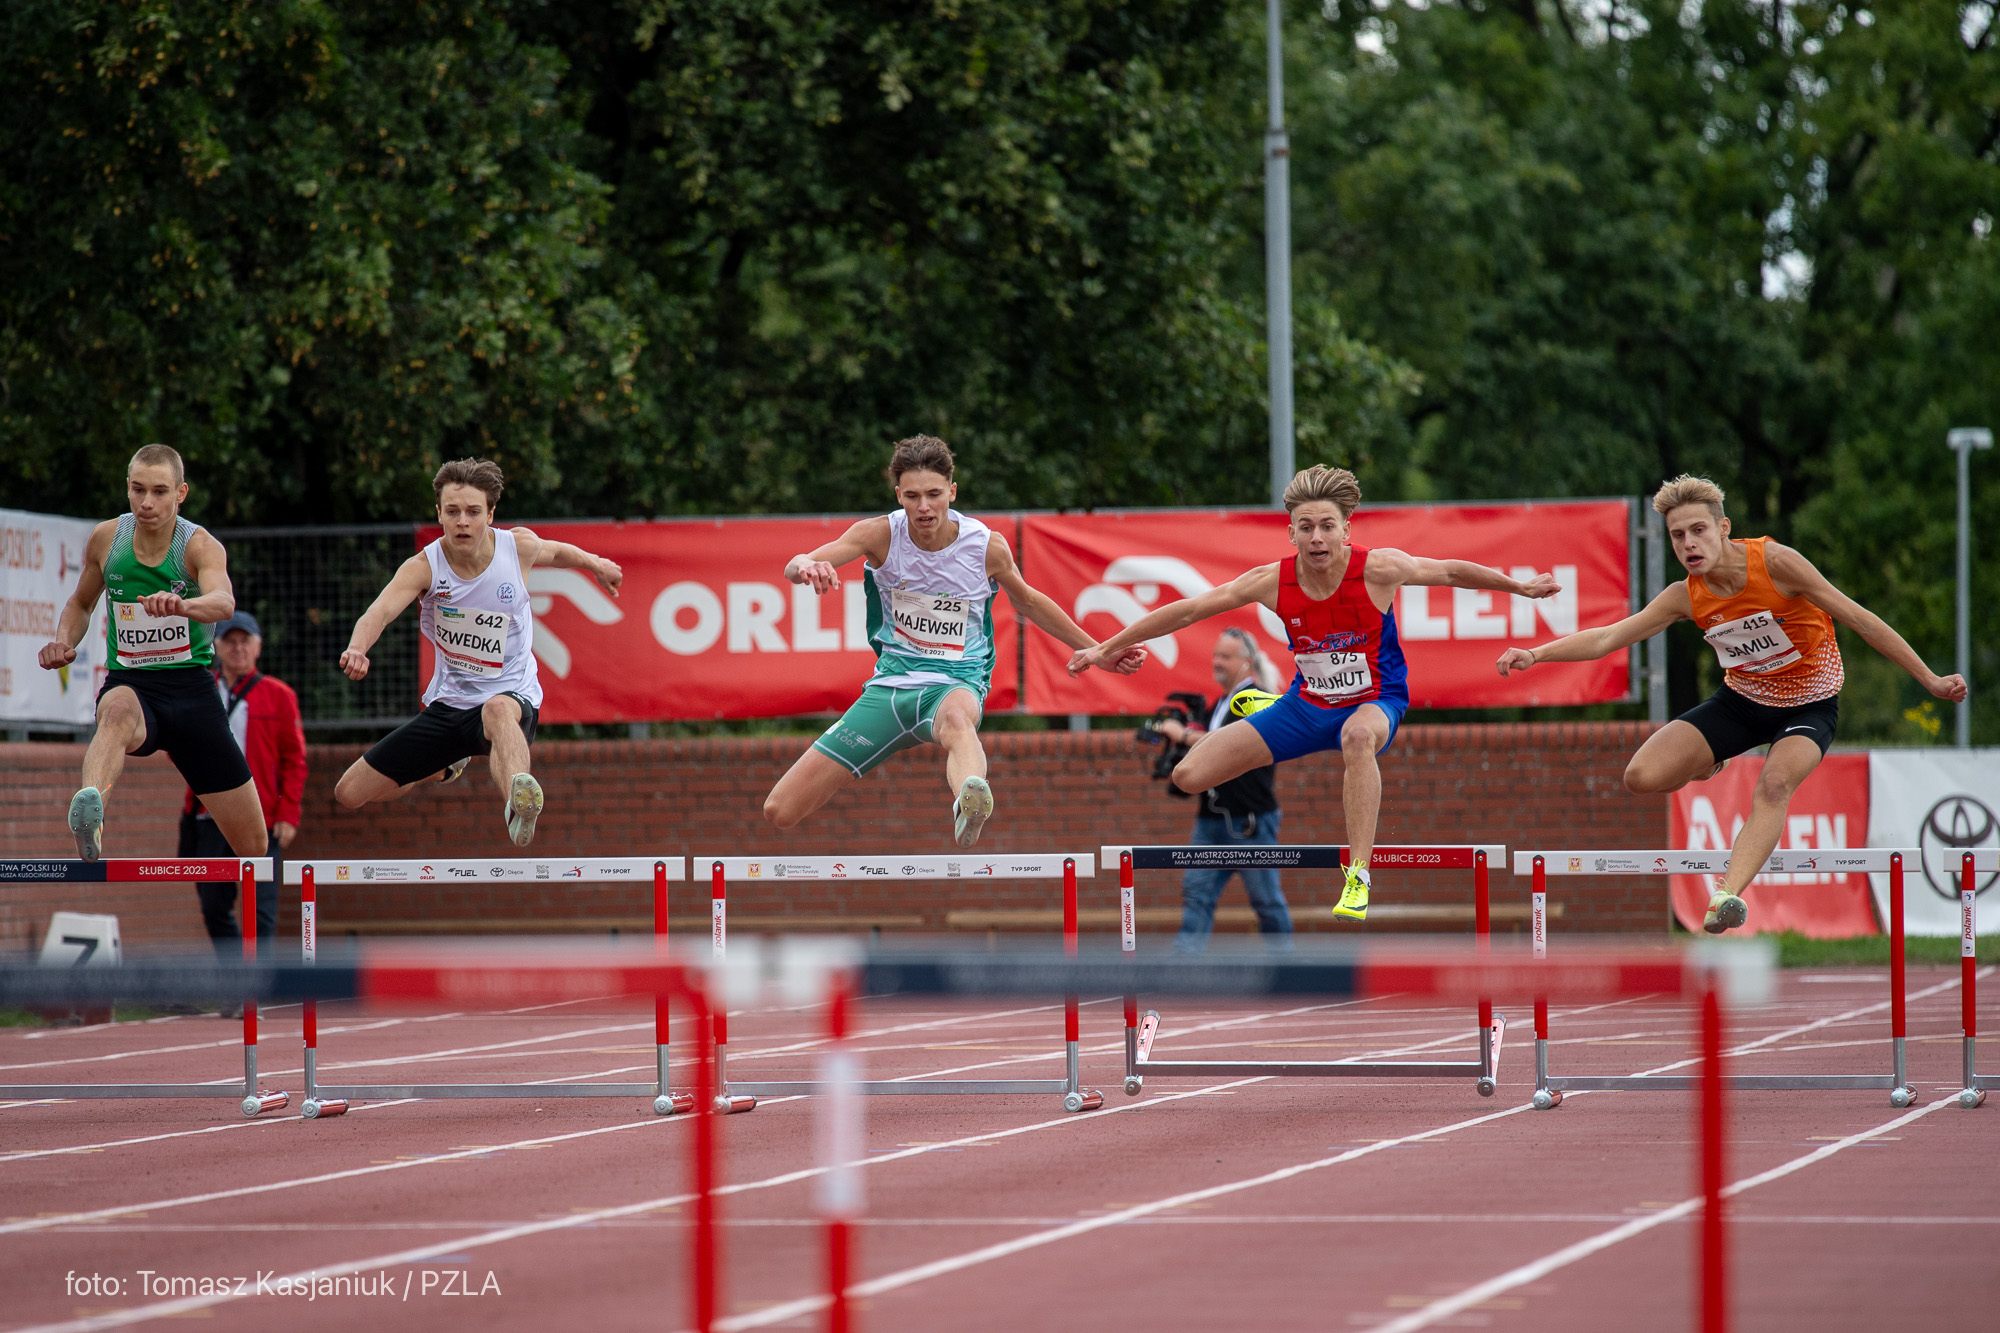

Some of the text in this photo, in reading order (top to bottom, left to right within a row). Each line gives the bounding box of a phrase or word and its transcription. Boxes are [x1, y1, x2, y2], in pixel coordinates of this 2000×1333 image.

[933, 600, 961, 612] 225
[475, 614, 503, 628] 642
[650, 580, 870, 655] ORL
[895, 610, 963, 636] MAJEWSKI
[1743, 616, 1769, 630] 415
[118, 626, 186, 647] KĘDZIOR
[437, 625, 501, 654] SZWEDKA
[1717, 628, 1735, 637] SPORT
[1726, 635, 1779, 658] SAMUL
[131, 657, 157, 665] SŁUBICE
[468, 664, 483, 673] 2023
[1330, 653, 1358, 665] 875
[1768, 660, 1784, 668] 2023
[1308, 671, 1364, 690] RAUHUT
[1372, 853, 1441, 863] SŁUBICE 2023
[139, 866, 207, 875] SŁUBICE 2023
[1124, 903, 1133, 934] polanik
[1535, 909, 1543, 942] polanik
[1964, 906, 1973, 940] polanik
[304, 918, 312, 951] polanik
[715, 915, 723, 948] polanik
[62, 935, 98, 968] 7
